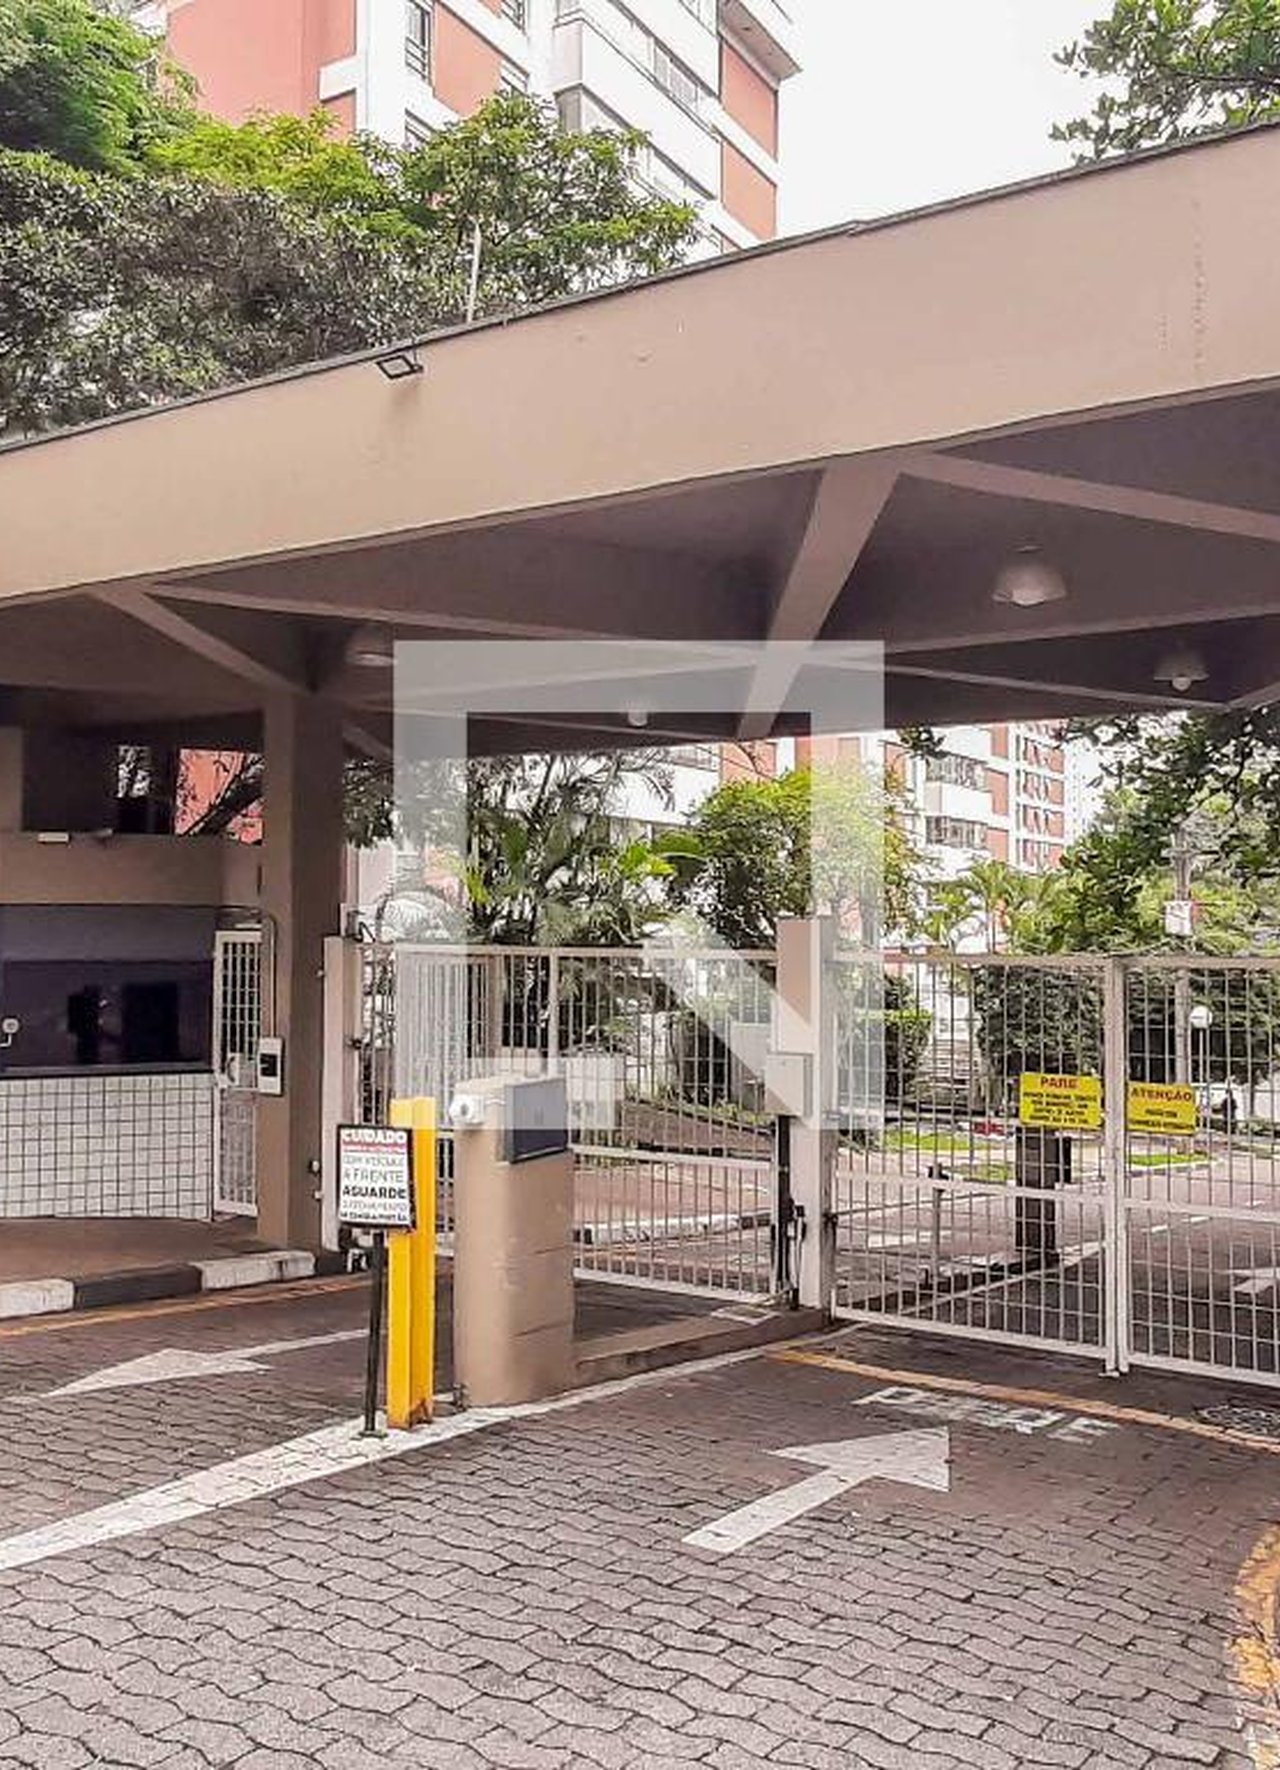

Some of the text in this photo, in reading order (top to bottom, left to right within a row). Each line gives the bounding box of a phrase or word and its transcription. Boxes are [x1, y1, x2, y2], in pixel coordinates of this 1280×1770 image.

[1040, 1077, 1078, 1089] PARE
[1131, 1087, 1192, 1101] ATENÇÃO
[342, 1128, 407, 1143] CUIDADO
[353, 1168, 404, 1183] FRENTE
[342, 1185, 407, 1200] AGUARDE
